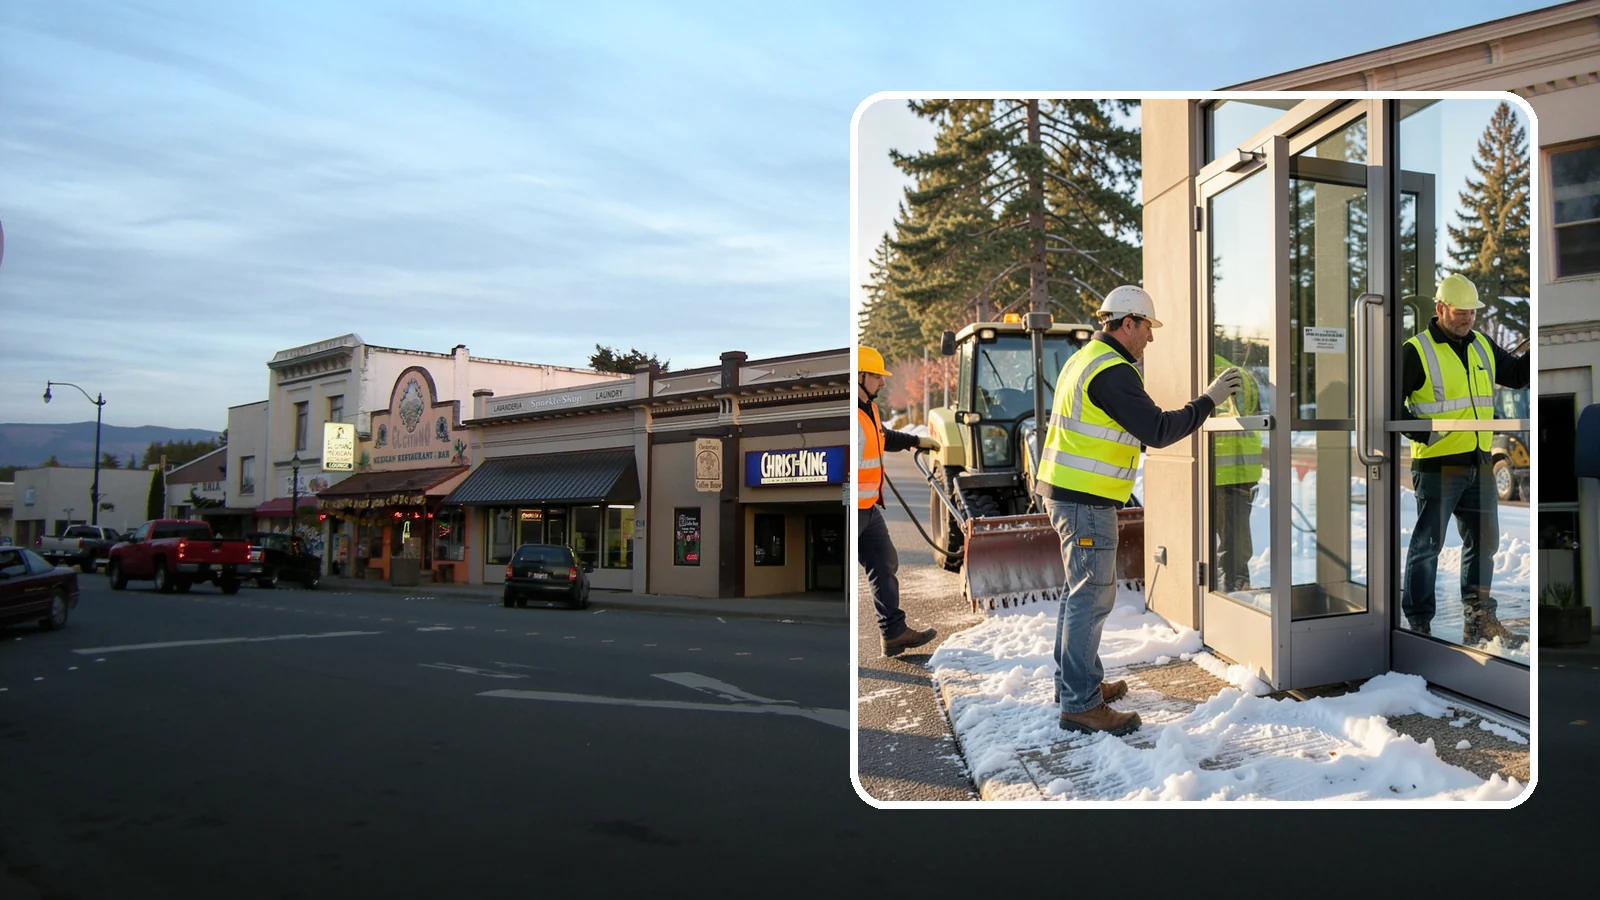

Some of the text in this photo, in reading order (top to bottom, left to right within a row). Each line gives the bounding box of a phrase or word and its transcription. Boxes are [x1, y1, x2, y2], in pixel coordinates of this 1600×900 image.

[595, 389, 623, 400] LAUNDRY
[493, 402, 522, 412] LAVANDERIA
[530, 394, 582, 409] Sparkle Shop
[397, 451, 433, 462] RESTAURANT
[437, 451, 450, 459] BAR
[760, 450, 827, 478] CHRIST KING
[696, 481, 709, 489] Coffee
